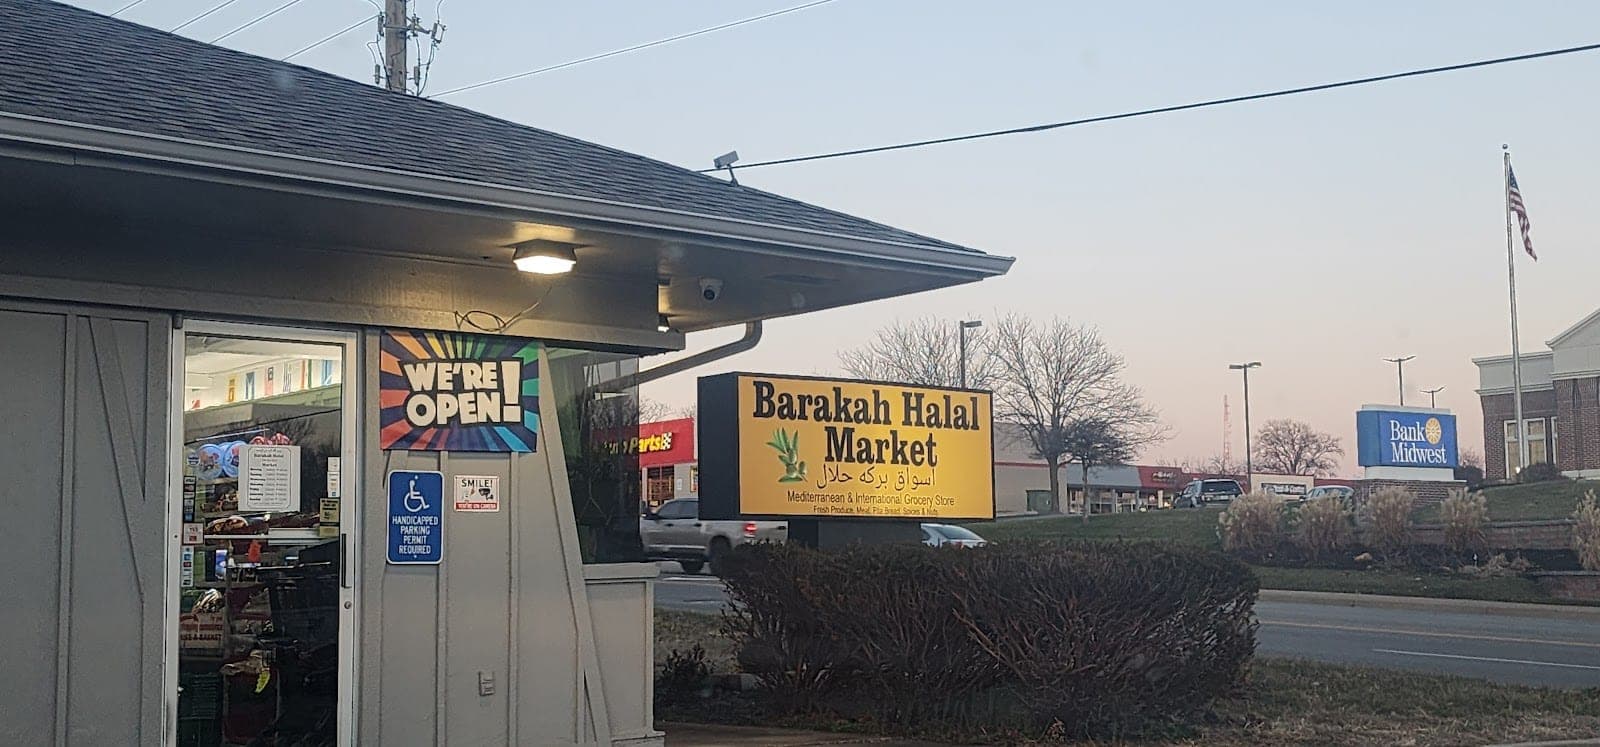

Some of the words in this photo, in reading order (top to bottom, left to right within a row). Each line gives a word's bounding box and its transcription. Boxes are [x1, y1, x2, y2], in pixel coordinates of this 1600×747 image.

[404, 361, 498, 392] WE'RE
[752, 380, 892, 426] Barakah
[901, 391, 980, 431] Halal
[1389, 420, 1426, 442] Bank
[824, 426, 938, 467] Market
[1390, 441, 1448, 464] Midwest
[461, 479, 493, 488] SMILE!
[816, 463, 854, 489] حلال
[787, 490, 845, 504] Mediterranean
[847, 491, 853, 503] &
[855, 492, 902, 505] International
[904, 493, 934, 509] Grocery
[935, 494, 955, 506] Store
[392, 515, 439, 526] HANDICAPPED
[400, 525, 431, 535] PARKING
[398, 545, 431, 555] REQUIRED
[403, 535, 428, 545] PERMIT
